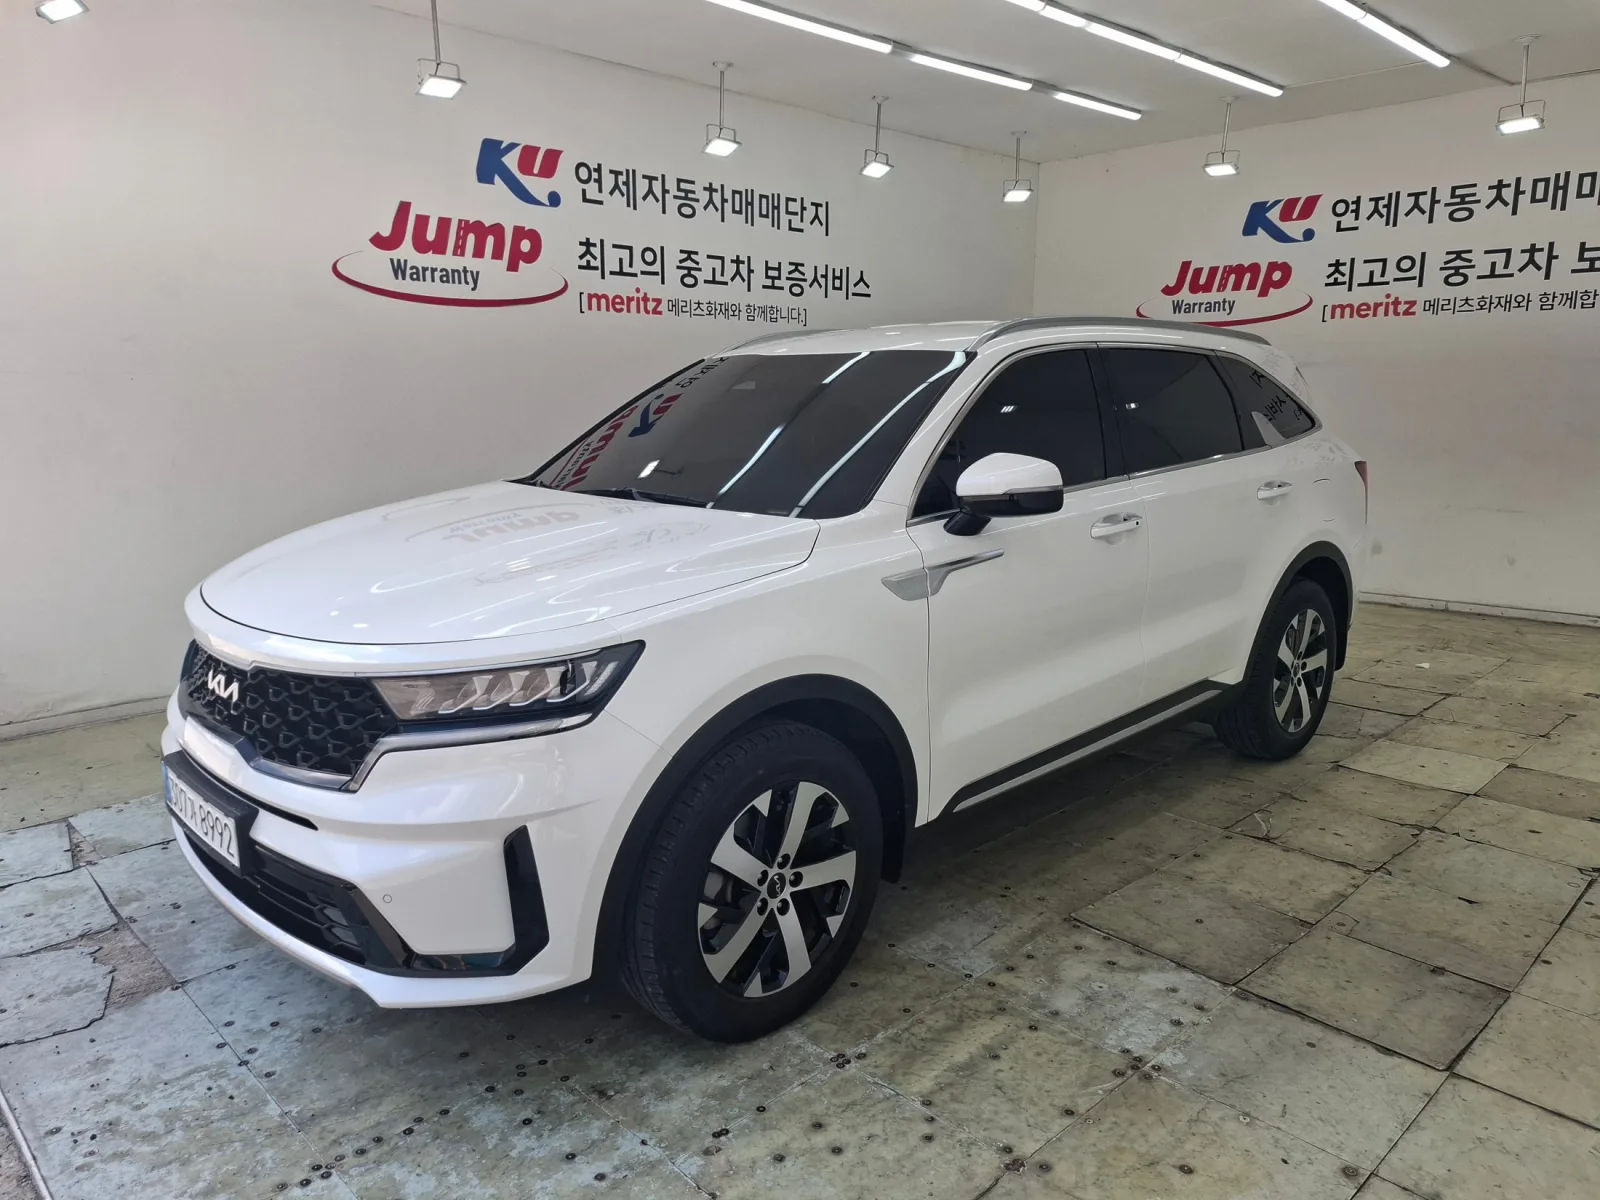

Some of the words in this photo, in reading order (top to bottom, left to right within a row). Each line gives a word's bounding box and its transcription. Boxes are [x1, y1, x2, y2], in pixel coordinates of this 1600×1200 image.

[574, 161, 830, 237] 연제자동차매매단지
[368, 200, 543, 273] Jump
[390, 257, 480, 292] Warranty
[577, 236, 666, 282] 최고의
[675, 248, 755, 292] 중고차
[761, 259, 872, 300] 보증서비스
[1160, 260, 1293, 297] Jump
[1324, 251, 1427, 292] 최고의
[1438, 241, 1560, 287] 중고차
[666, 298, 742, 322] 메리츠화재와
[1171, 298, 1236, 316] Warranty
[1422, 293, 1533, 316] 메리츠화재와
[199, 803, 235, 858] 8992
